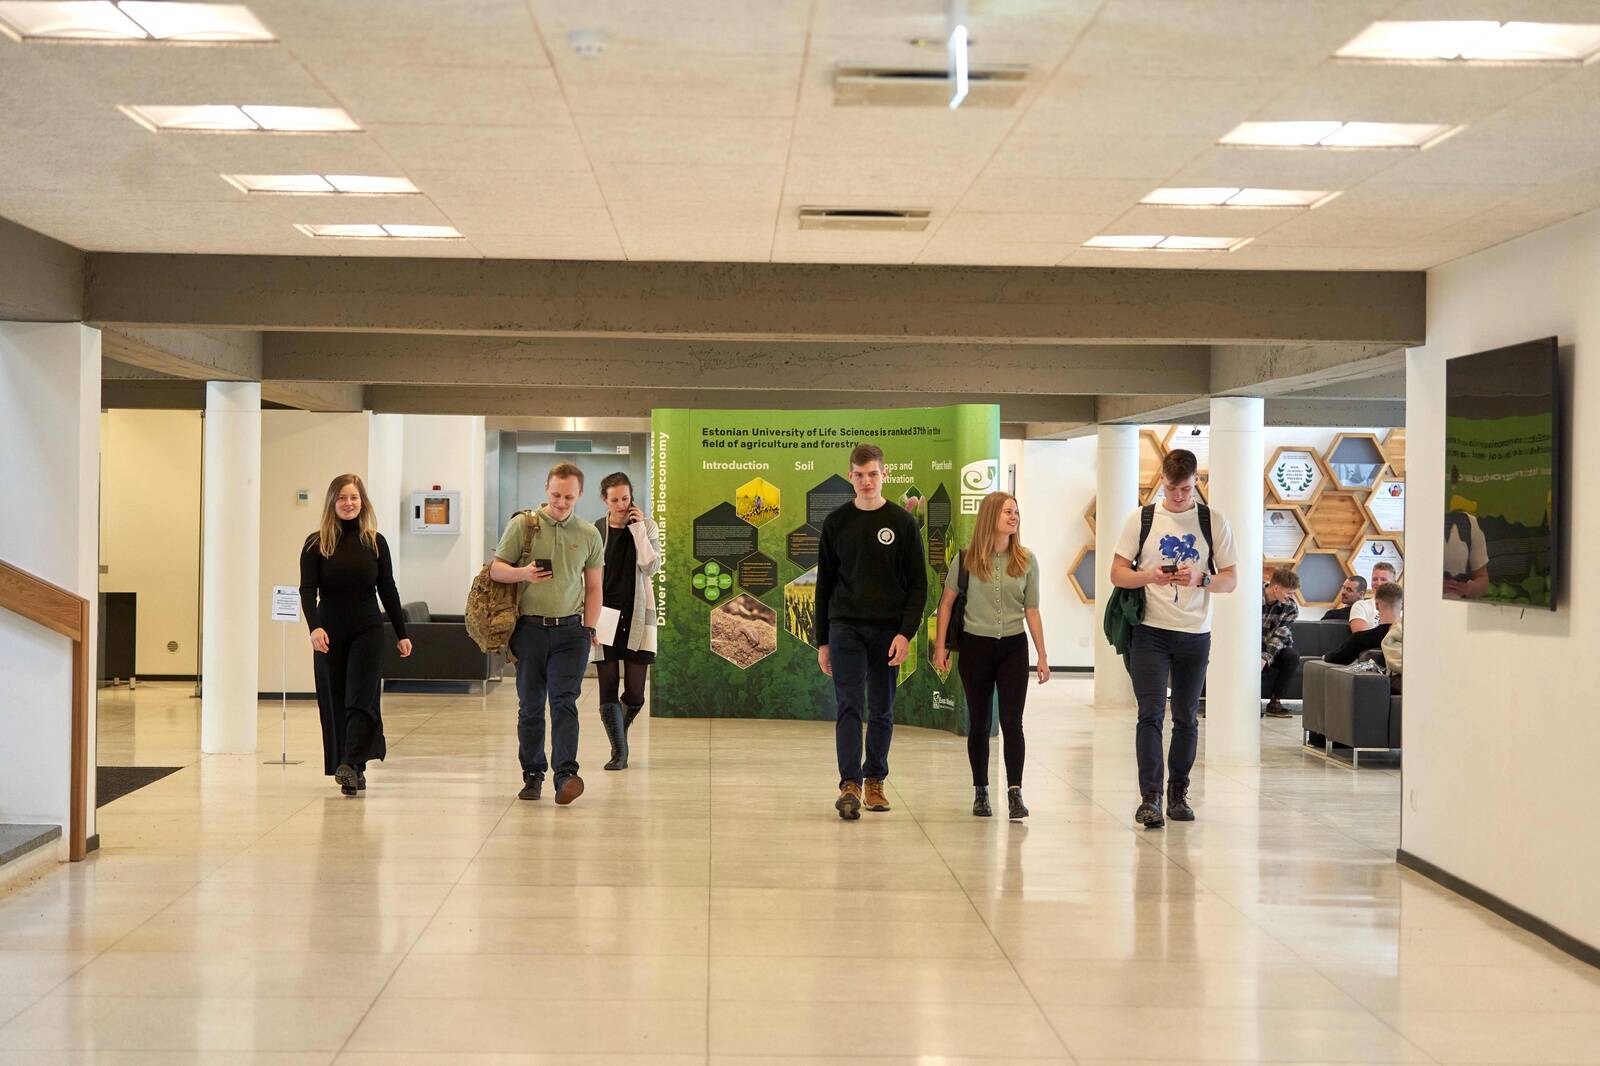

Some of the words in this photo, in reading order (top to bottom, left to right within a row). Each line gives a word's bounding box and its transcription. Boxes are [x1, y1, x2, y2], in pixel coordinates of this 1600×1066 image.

[702, 427, 749, 437] Estonian
[752, 427, 805, 438] University
[807, 428, 817, 437] of
[819, 428, 837, 437] Life
[840, 427, 879, 437] Sciences
[880, 427, 887, 437] is
[887, 427, 912, 436] ranked
[912, 426, 926, 436] 37th
[702, 439, 725, 448] field
[727, 439, 739, 448] of
[740, 439, 799, 450] agriculture
[801, 440, 819, 449] and
[821, 440, 859, 449] forestry
[702, 460, 770, 470] Introduction
[794, 461, 815, 471] Soil
[883, 463, 898, 473] ops
[899, 460, 913, 471] and
[656, 431, 670, 513] Bioeconomy
[657, 514, 667, 566] Circular
[656, 568, 667, 583] of
[656, 585, 667, 626] Driver
